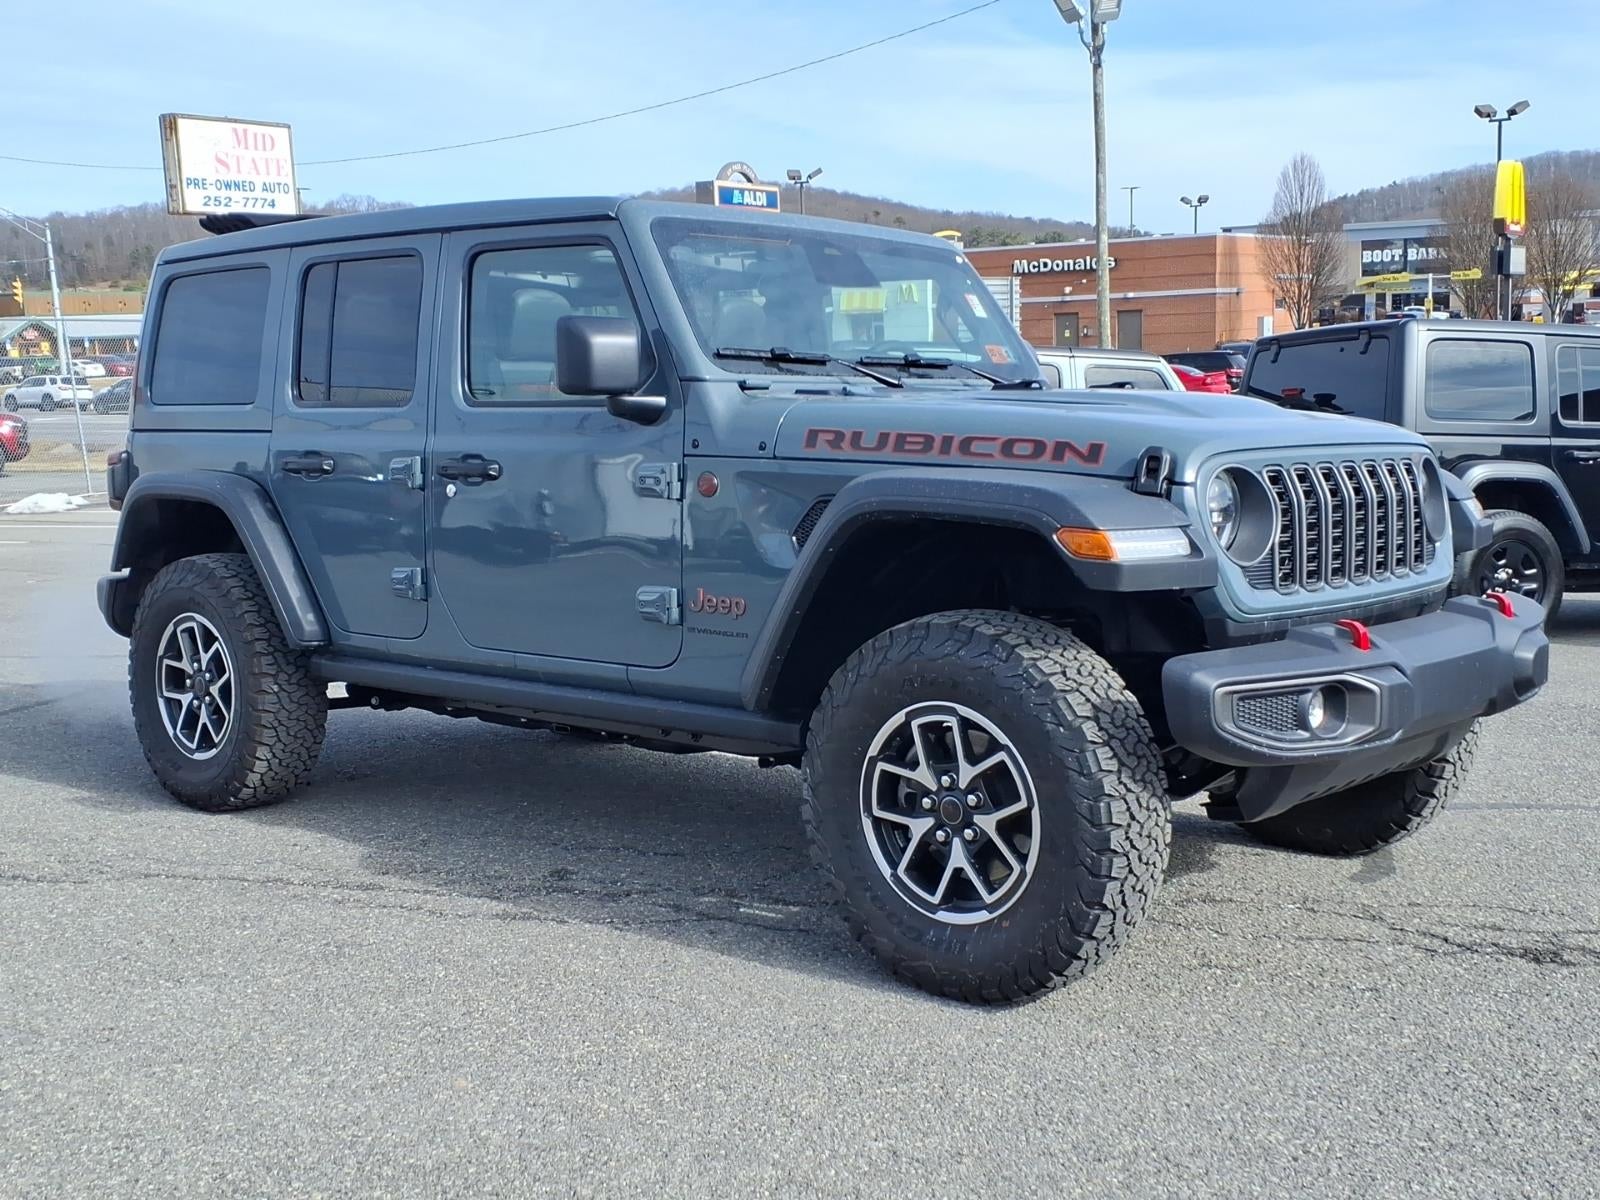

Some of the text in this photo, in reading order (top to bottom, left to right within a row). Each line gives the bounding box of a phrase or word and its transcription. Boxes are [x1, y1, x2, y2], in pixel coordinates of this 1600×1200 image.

[231, 126, 276, 152] MID
[214, 151, 289, 177] STATE
[186, 177, 290, 195] PRE-OWNED AUTO
[202, 195, 276, 209] 252-7774
[743, 191, 767, 206] ALDI
[1013, 255, 1116, 273] McDonals
[1362, 248, 1403, 263] BOOT
[803, 427, 1106, 467] RUBICON
[689, 587, 747, 620] Jeep
[696, 627, 749, 639] WRANGLER
